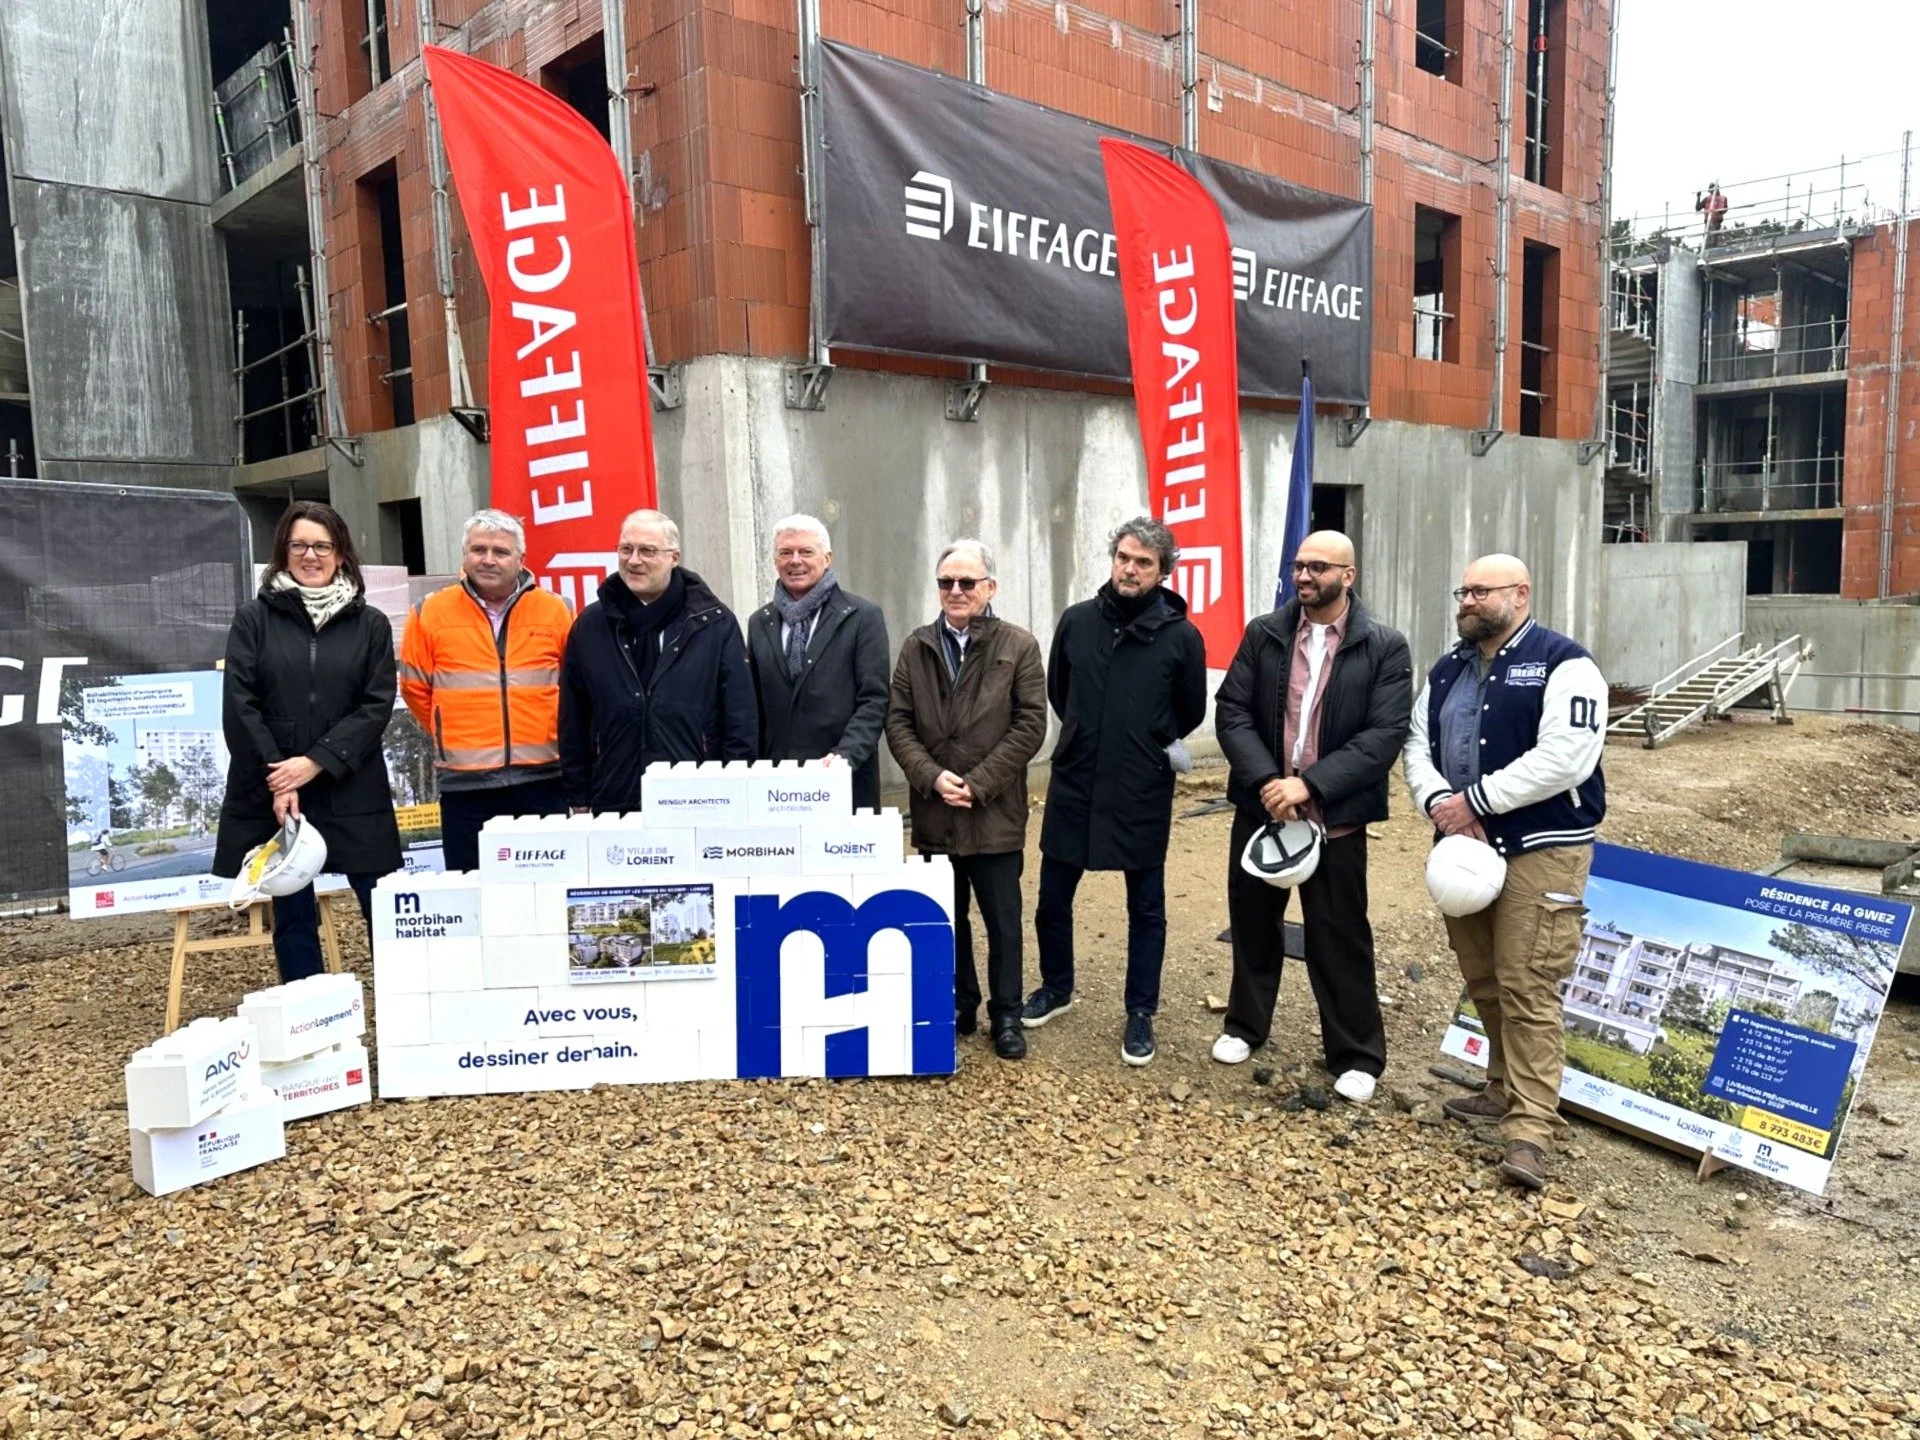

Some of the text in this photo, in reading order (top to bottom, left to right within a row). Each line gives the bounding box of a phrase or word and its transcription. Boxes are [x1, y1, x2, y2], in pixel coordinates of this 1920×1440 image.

[968, 201, 1117, 277] EIFFAGE
[1262, 267, 1364, 321] EIFFAGE
[767, 789, 830, 802] Nomade
[515, 849, 567, 861] EIFFAGE
[726, 846, 795, 857] MORBIHAN
[627, 855, 675, 866] LORIENT
[1760, 885, 1896, 925] RÉSIDENCE AR GWEZ
[395, 913, 462, 926] morbihan
[1744, 897, 1892, 938] POSE DE LA PREMIÈRE PIERRE
[396, 926, 446, 939] habitat
[289, 1008, 352, 1036] ActionLogement
[523, 1006, 638, 1026] Avec vous,
[1750, 1019, 1784, 1035] logements
[1785, 1030, 1809, 1043] locatifs
[1810, 1037, 1837, 1050] sociaux
[1762, 1033, 1772, 1041] de
[458, 1041, 638, 1069] dessiner demain.
[1756, 1051, 1766, 1060] de
[1763, 1043, 1773, 1051] de
[1750, 1069, 1760, 1077] de
[1753, 1061, 1763, 1069] de
[281, 1077, 320, 1093] BANQUE
[282, 1082, 340, 1101] TERRITOIRES
[1725, 1086, 1736, 1094] 1er
[1736, 1089, 1766, 1104] trimestre
[1726, 1079, 1818, 1115] LIVRAISON PRÉVISIONNELLE
[1633, 1104, 1671, 1122] MORBIHAN
[1759, 1121, 1821, 1149] 8 773 483€
[1753, 1159, 1779, 1174] habitat
[1755, 1154, 1789, 1171] morbihan
